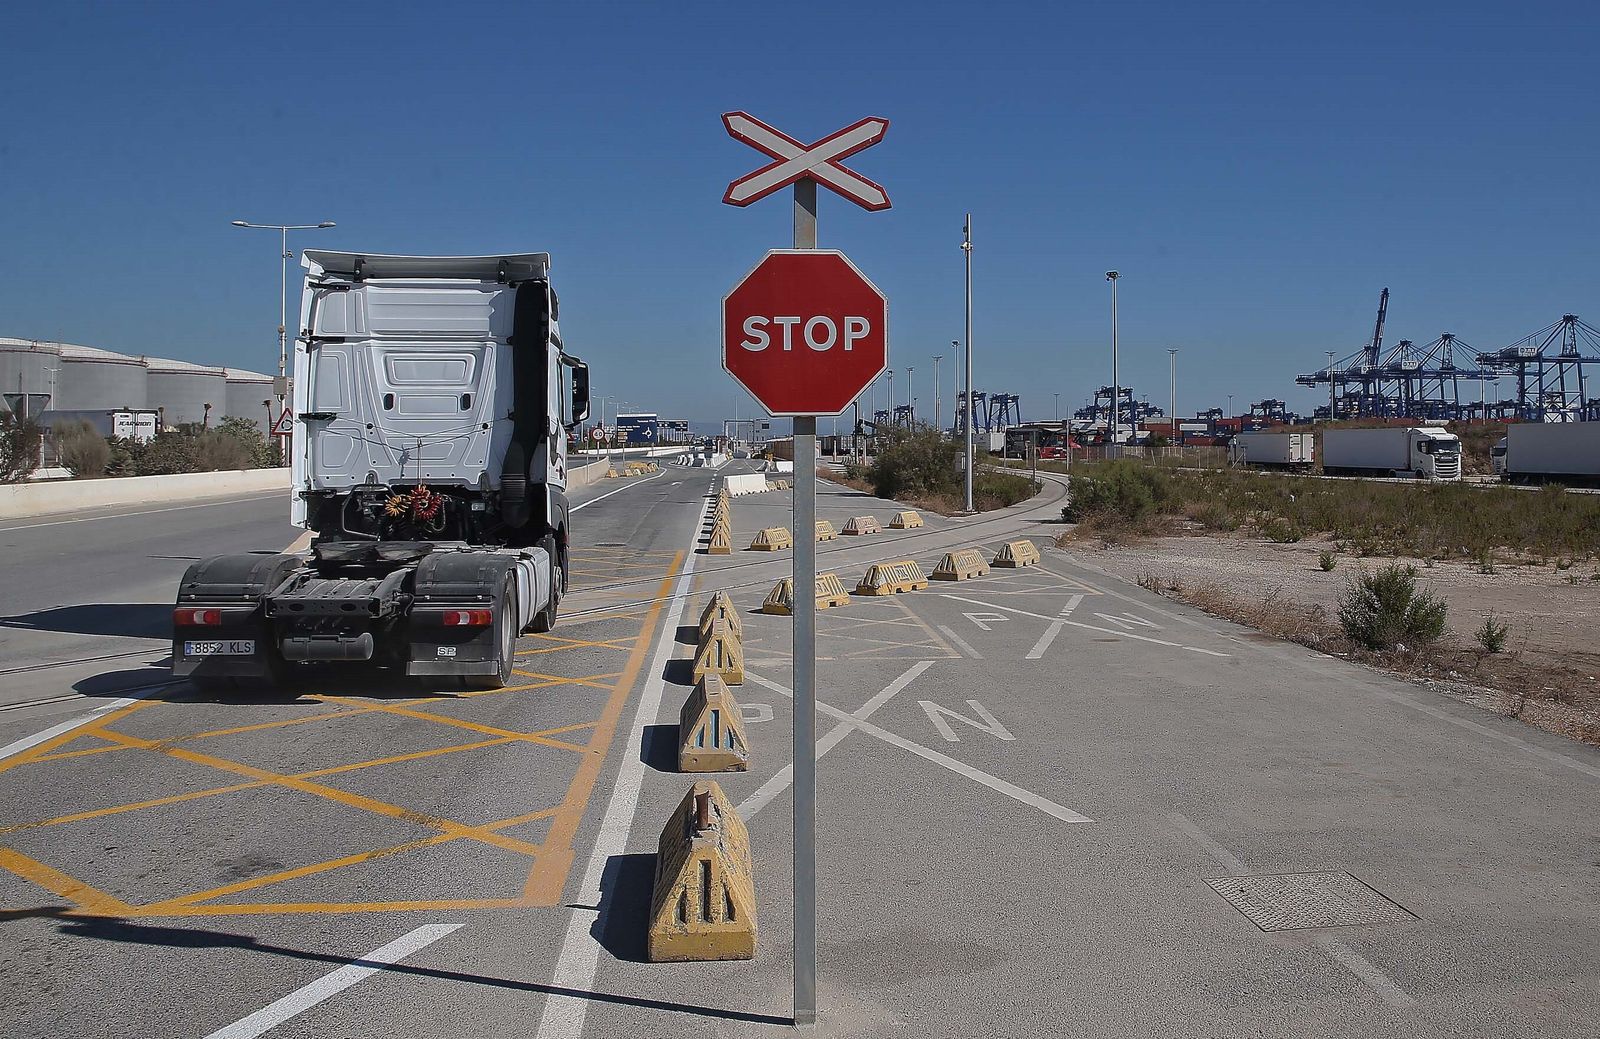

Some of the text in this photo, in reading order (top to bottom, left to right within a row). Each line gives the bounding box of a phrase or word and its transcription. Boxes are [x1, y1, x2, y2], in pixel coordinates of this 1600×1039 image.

[740, 315, 870, 351] STOP
[962, 612, 1165, 631] P N
[195, 642, 251, 654] 8852 KLS
[438, 646, 455, 656] SP
[918, 700, 1017, 742] N
